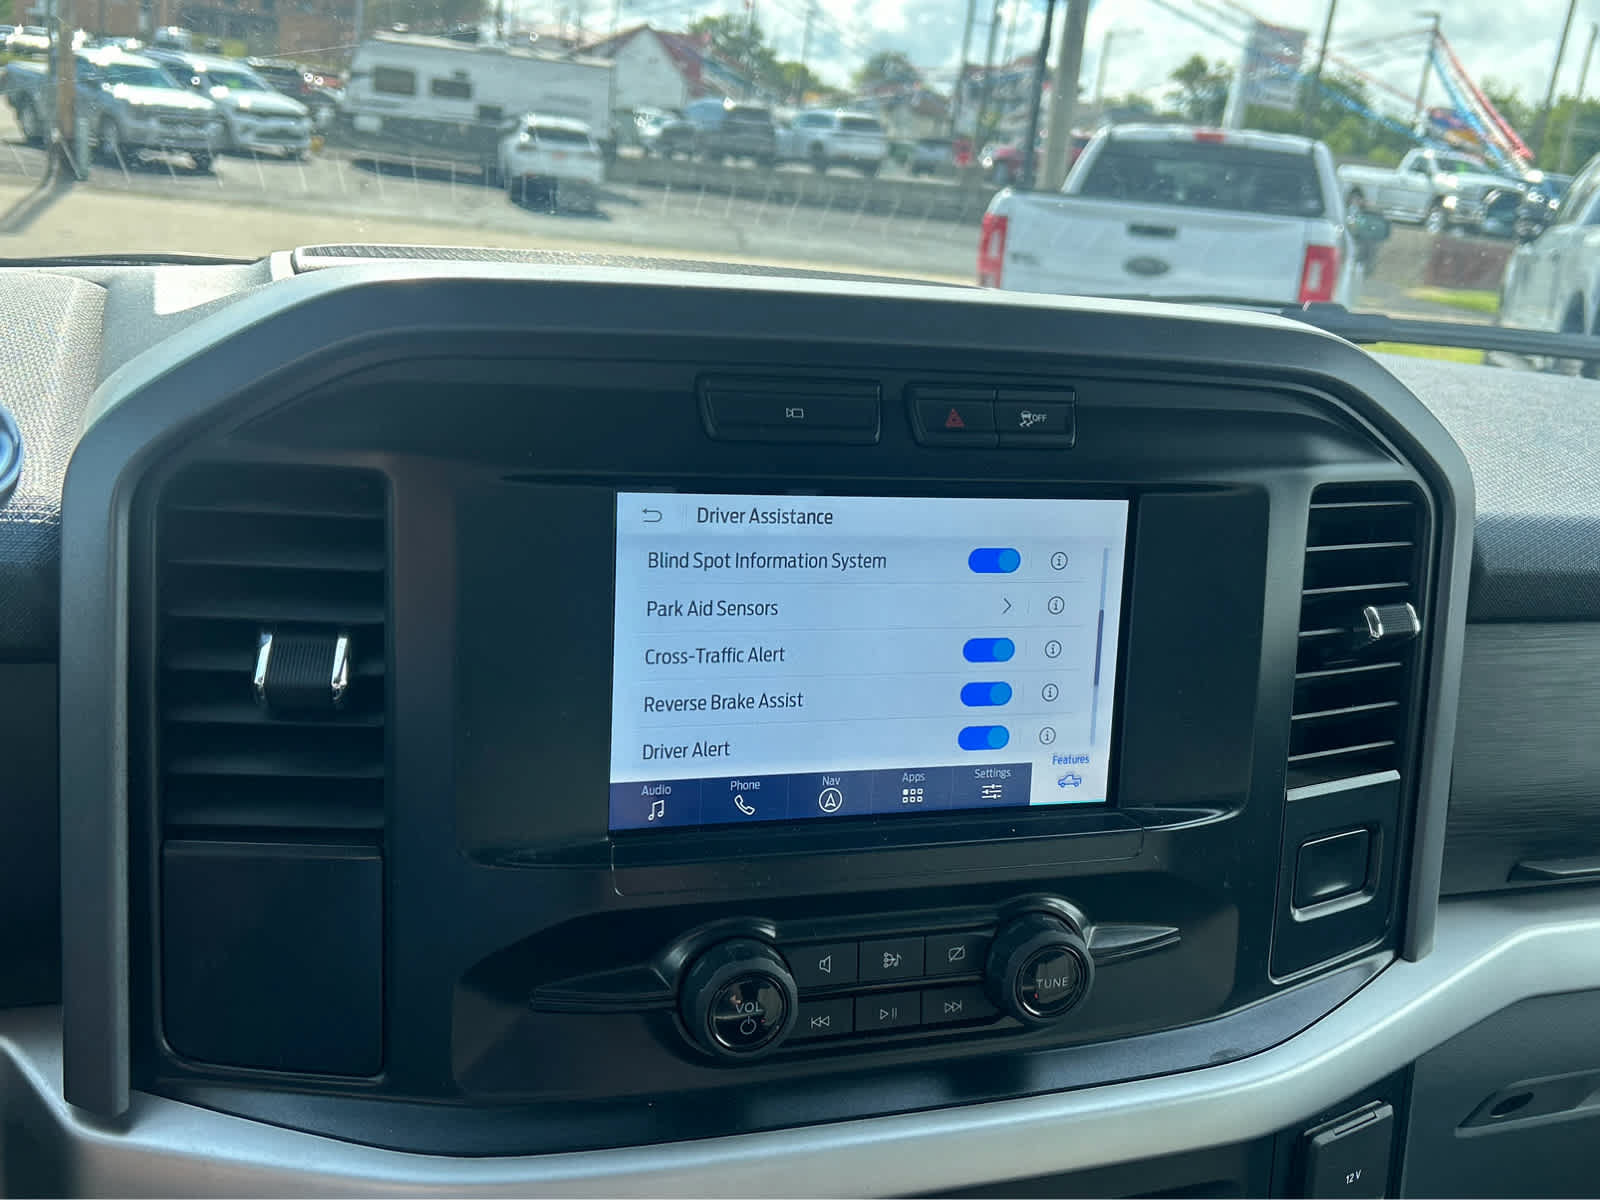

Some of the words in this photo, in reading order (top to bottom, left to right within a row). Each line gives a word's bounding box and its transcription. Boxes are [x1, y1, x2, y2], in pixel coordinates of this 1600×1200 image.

[1032, 414, 1047, 423] OFF
[696, 506, 746, 524] Driver
[748, 507, 833, 525] Assistance
[648, 551, 689, 569] Blind
[692, 551, 731, 572] Spot
[735, 551, 828, 569] Information
[831, 552, 887, 572] System
[647, 599, 683, 617] Park
[686, 599, 713, 617] Aid
[716, 600, 778, 617] Sensors
[645, 647, 745, 665] Cross-Traffic
[747, 646, 785, 663] Alert
[644, 696, 707, 713] Reverse
[711, 693, 755, 711] Brake
[758, 692, 804, 709] Assist
[642, 743, 689, 760] Driver
[691, 741, 731, 758] Alert
[1052, 754, 1090, 765] Features
[902, 772, 926, 783] Apps
[974, 767, 1012, 780] Settings
[730, 780, 761, 791] Phone
[822, 775, 841, 786] Nav
[640, 784, 672, 796] Audio
[1036, 977, 1069, 989] TUNE
[735, 1002, 762, 1014] VOL
